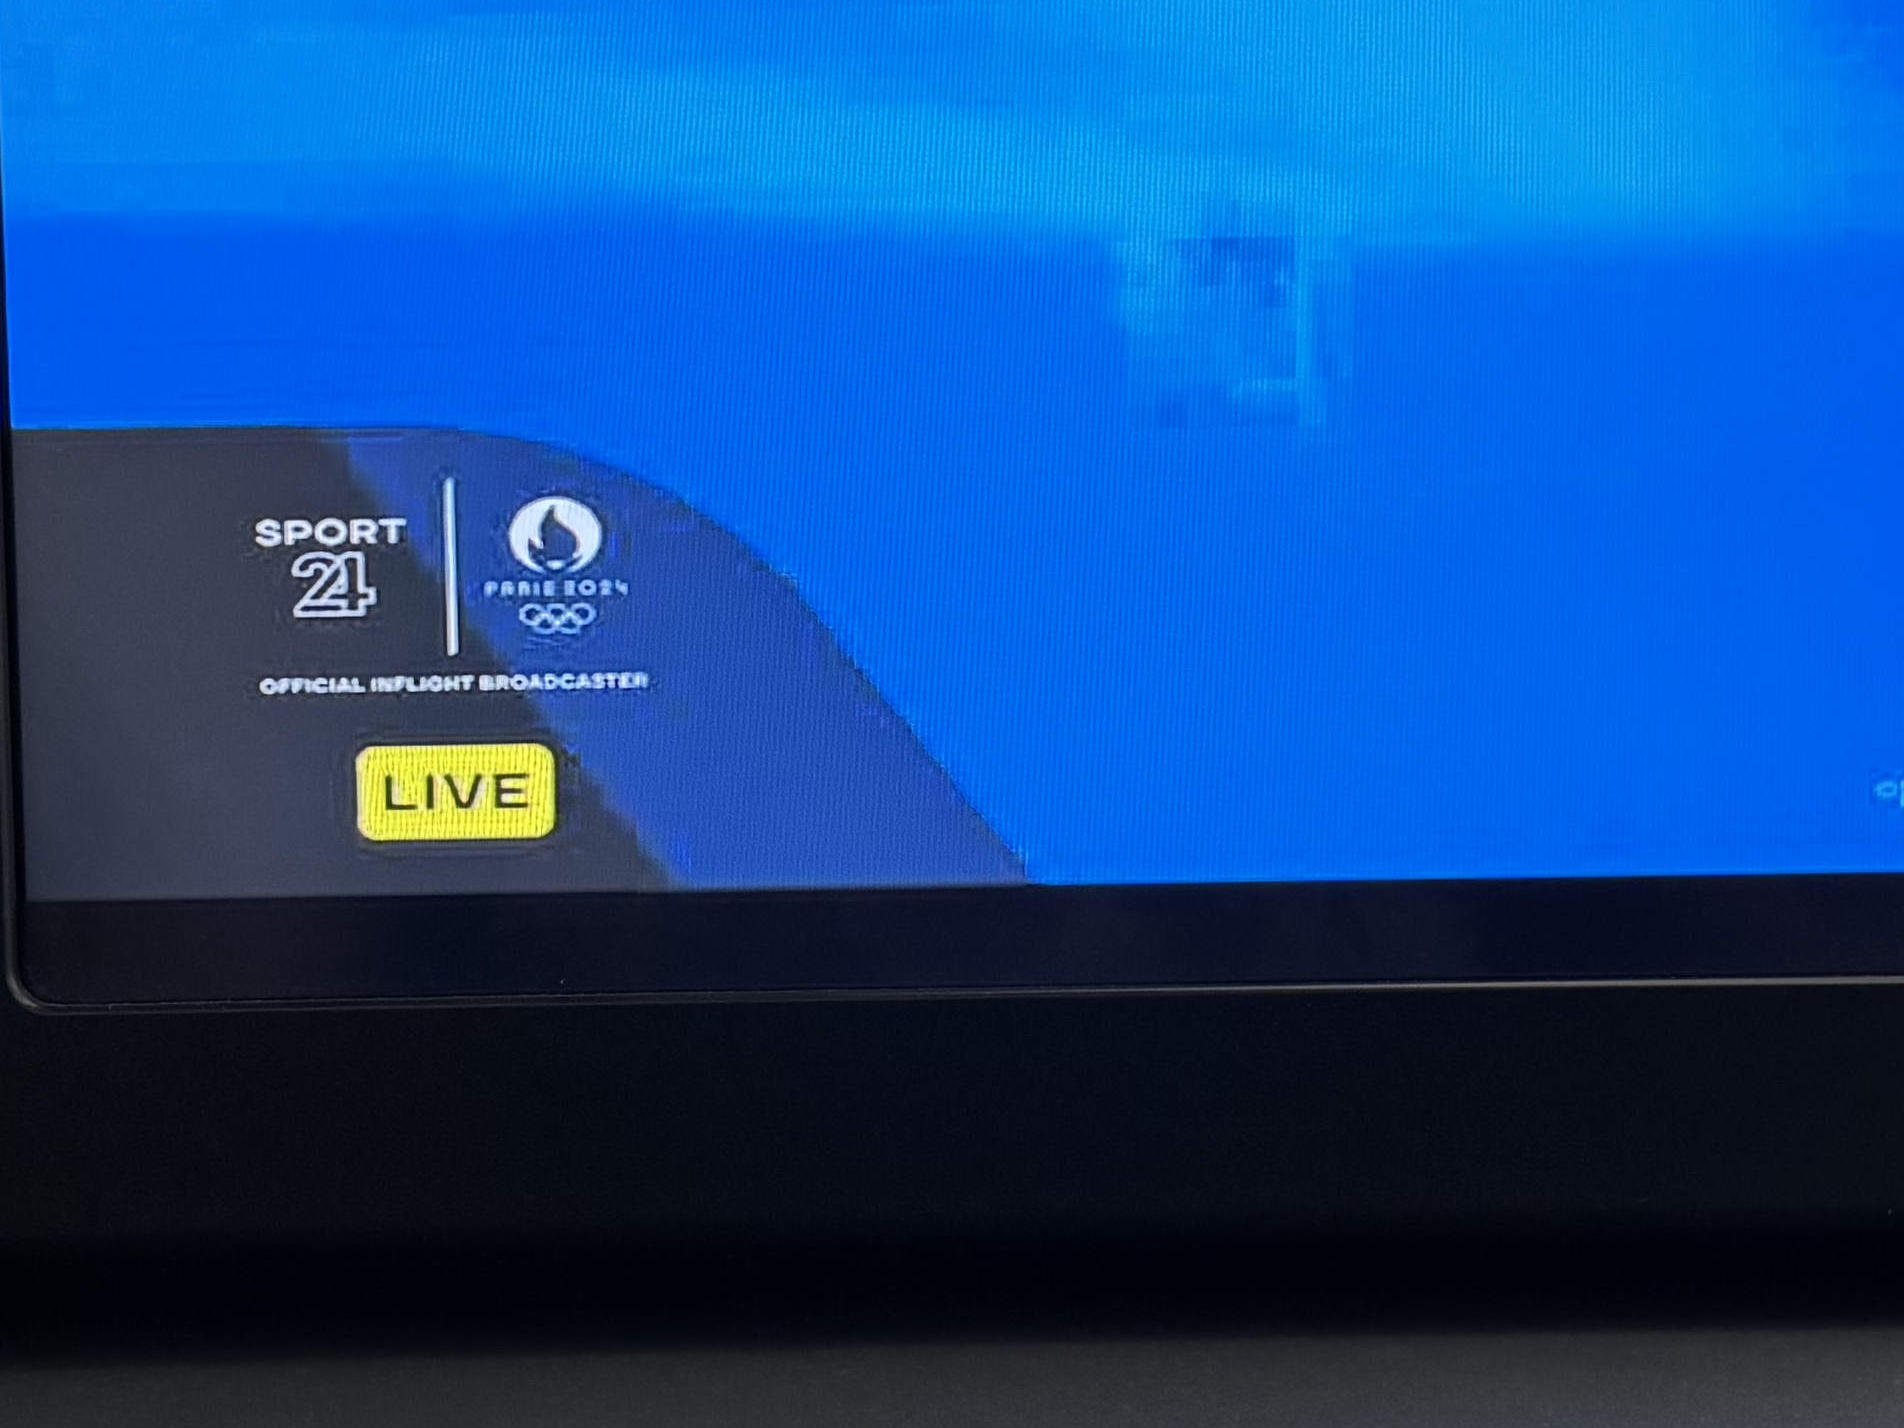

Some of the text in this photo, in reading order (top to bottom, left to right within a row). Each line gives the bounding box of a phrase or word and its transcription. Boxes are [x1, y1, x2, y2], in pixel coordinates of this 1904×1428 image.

[255, 518, 407, 547] SPORT
[259, 673, 649, 695] OFFICIAL INFLIGHT BROADCASTER
[385, 773, 530, 812] LIVE
